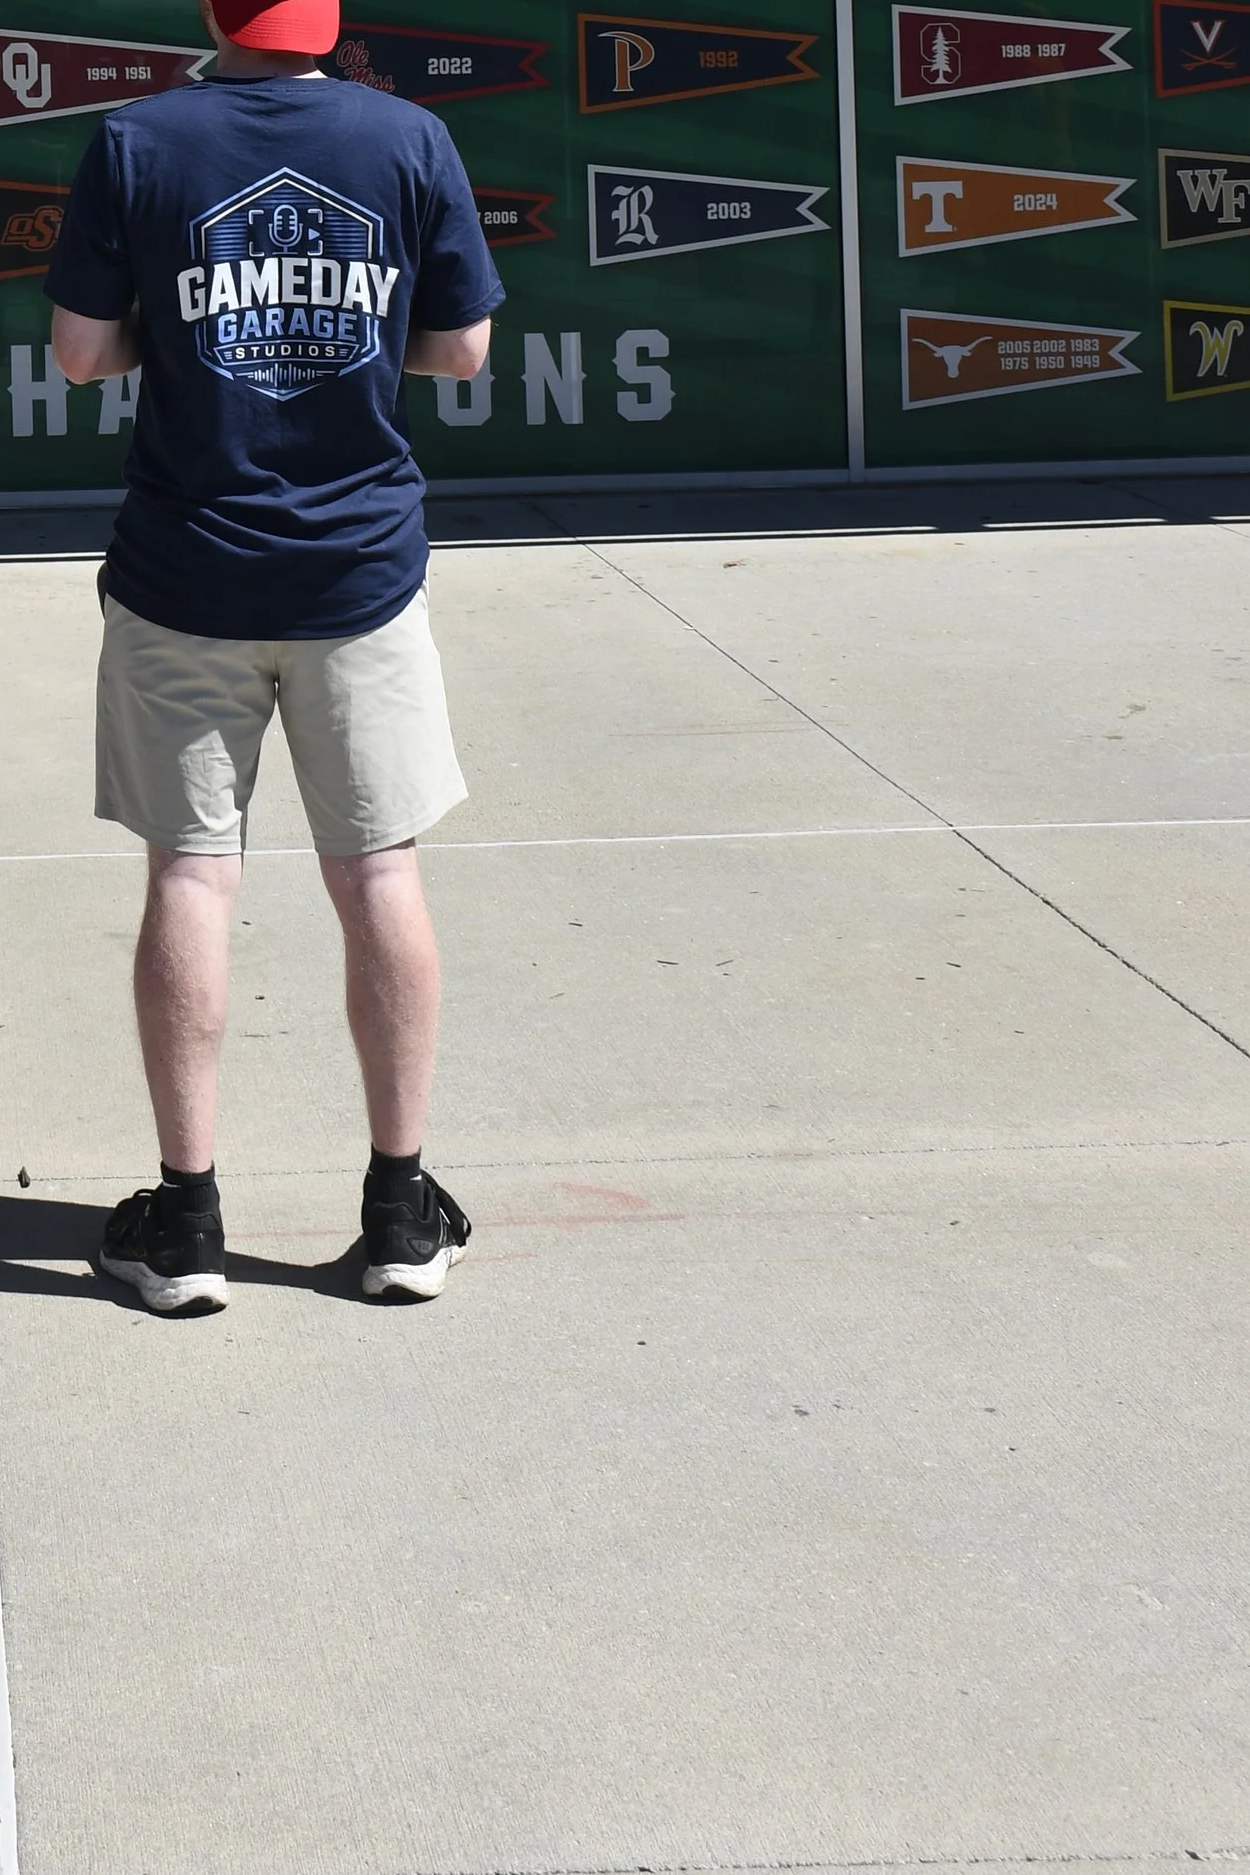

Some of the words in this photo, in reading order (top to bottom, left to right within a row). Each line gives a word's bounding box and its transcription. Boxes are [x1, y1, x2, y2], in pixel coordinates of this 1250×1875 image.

[336, 40, 369, 68] Ole
[1001, 43, 1031, 59] 1988
[1038, 42, 1066, 58] 1987
[427, 57, 473, 76] 2022
[597, 30, 655, 92] P
[699, 50, 738, 69] 1992
[86, 67, 117, 81] 1994
[124, 66, 151, 80] 1951
[610, 184, 659, 246] R
[707, 201, 751, 221] 2003
[912, 180, 963, 233] T
[1013, 193, 1058, 211] 2024
[484, 211, 518, 225] 2006
[176, 257, 400, 323] GAMEDAY
[217, 307, 358, 344] GARAGE
[235, 345, 336, 359] STUDIOS
[997, 340, 1031, 354] 2005
[1033, 339, 1066, 353] 2002
[1070, 338, 1100, 352] 1983
[1000, 356, 1029, 370] 1975
[1035, 356, 1065, 369] 1950
[1070, 355, 1100, 368] 1949
